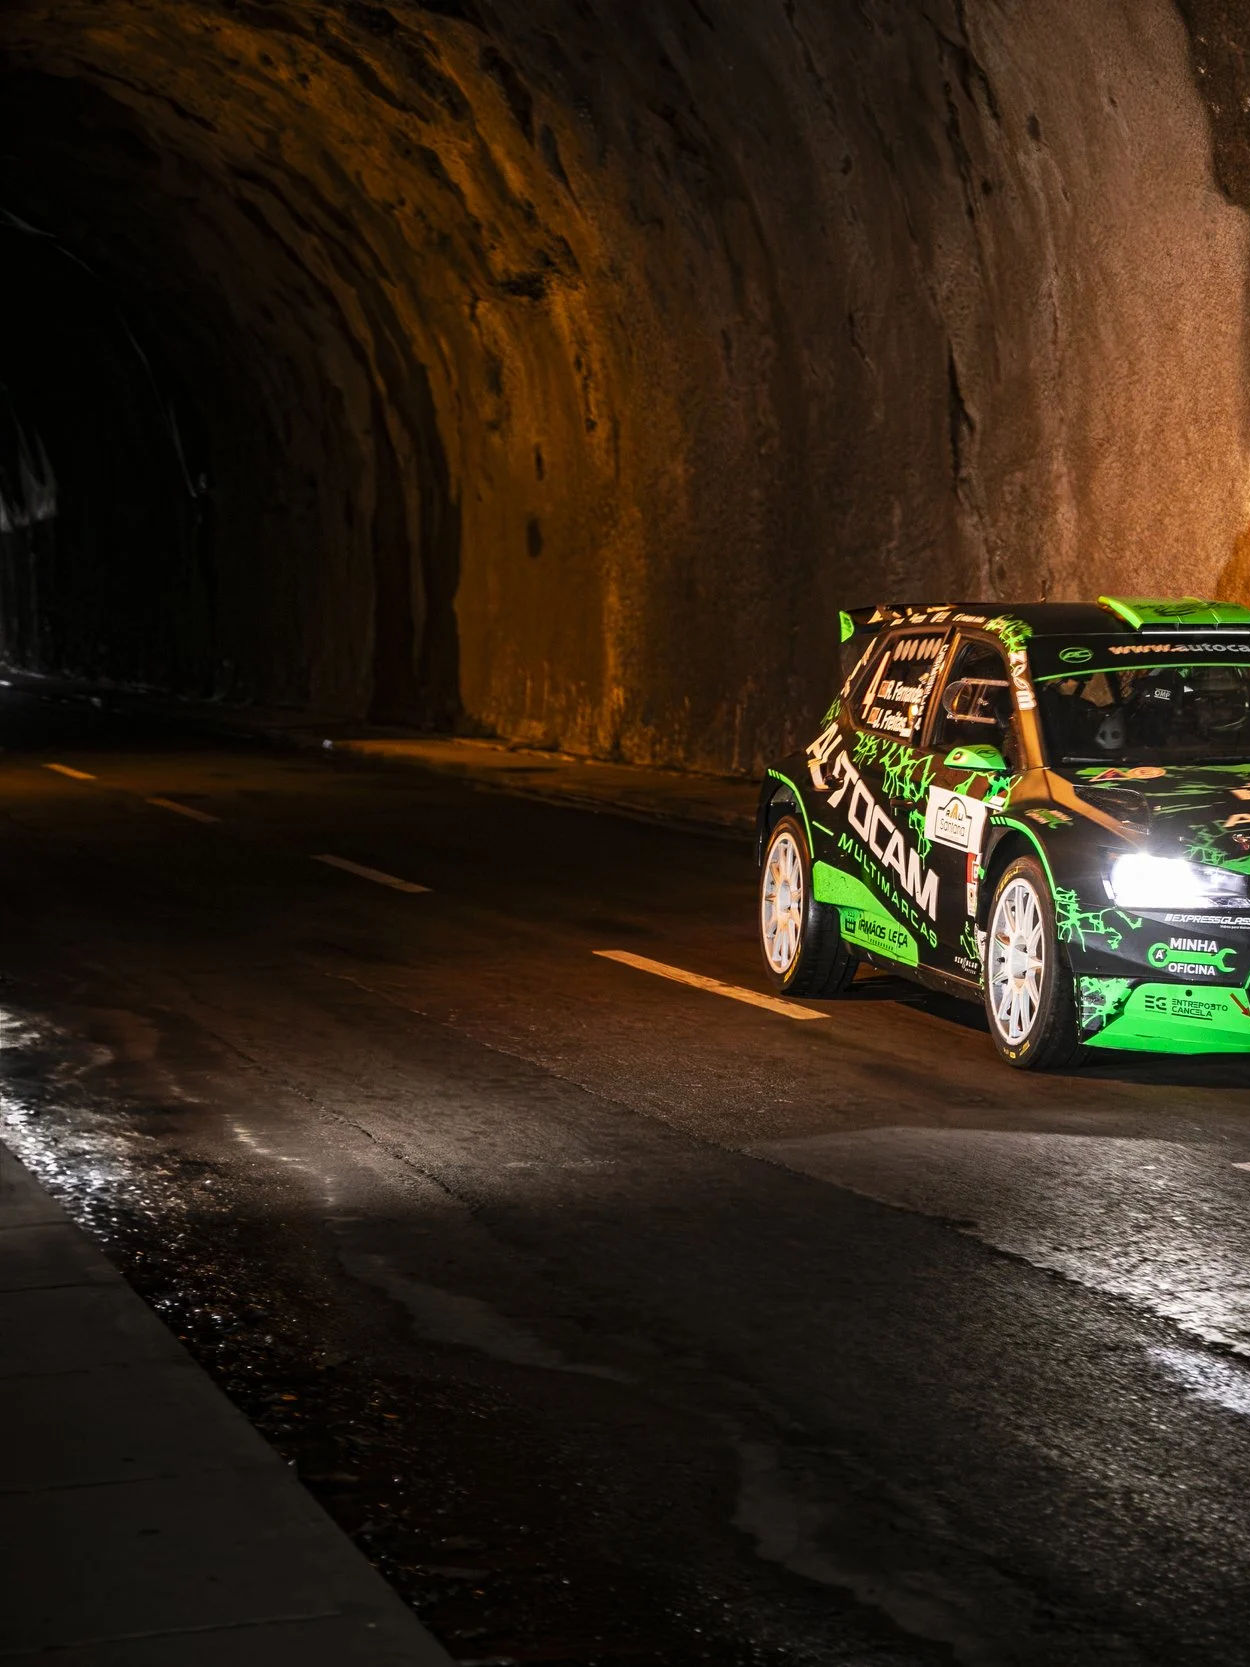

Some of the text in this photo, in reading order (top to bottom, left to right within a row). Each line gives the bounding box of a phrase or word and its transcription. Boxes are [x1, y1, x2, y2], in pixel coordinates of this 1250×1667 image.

[1154, 688, 1171, 699] OMP
[837, 832, 939, 949] MULTIMARCAS
[858, 919, 887, 940] IRMÃOS
[888, 924, 909, 949] LEÇA
[1170, 938, 1218, 952] MINHA
[1168, 962, 1216, 976] OFICINA
[1171, 998, 1228, 1012] ENTREPOSTO
[1171, 1006, 1213, 1018] CANCELA
